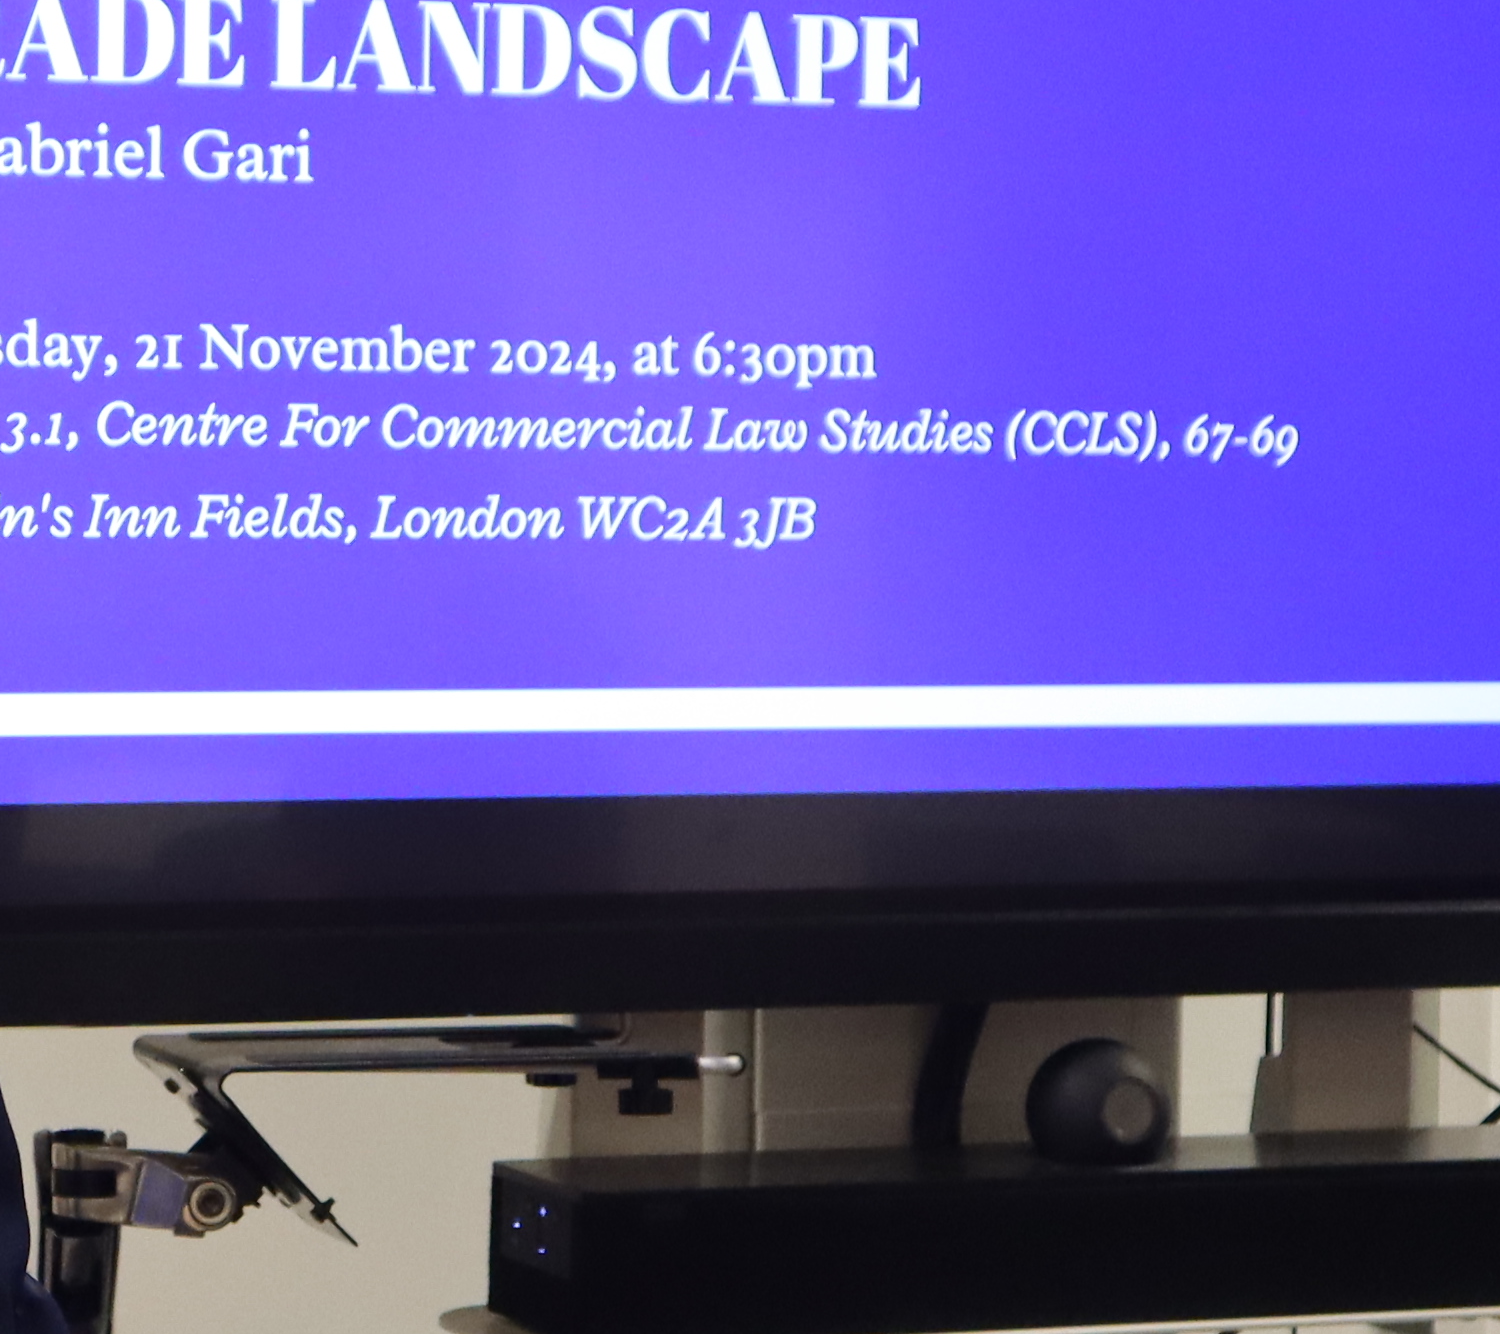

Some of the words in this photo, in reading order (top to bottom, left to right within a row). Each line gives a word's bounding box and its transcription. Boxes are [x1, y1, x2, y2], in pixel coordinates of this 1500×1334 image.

[181, 126, 315, 185] Gari
[134, 332, 184, 371] 21
[197, 322, 477, 375] November
[489, 338, 618, 384] 2024,
[631, 333, 681, 378] at
[691, 330, 879, 391] 6:30pm
[95, 398, 269, 449] Centre
[278, 401, 372, 449] For
[380, 401, 695, 452] Commercial
[701, 406, 809, 453] Law
[817, 406, 995, 455] Studies
[1003, 407, 1172, 464] (CCLS),
[1182, 412, 1300, 468] 67-69
[81, 492, 182, 540] Inn
[188, 491, 358, 546] Fields,
[368, 492, 566, 541] London
[576, 493, 727, 543] WC2A
[732, 495, 818, 551] 3JB
